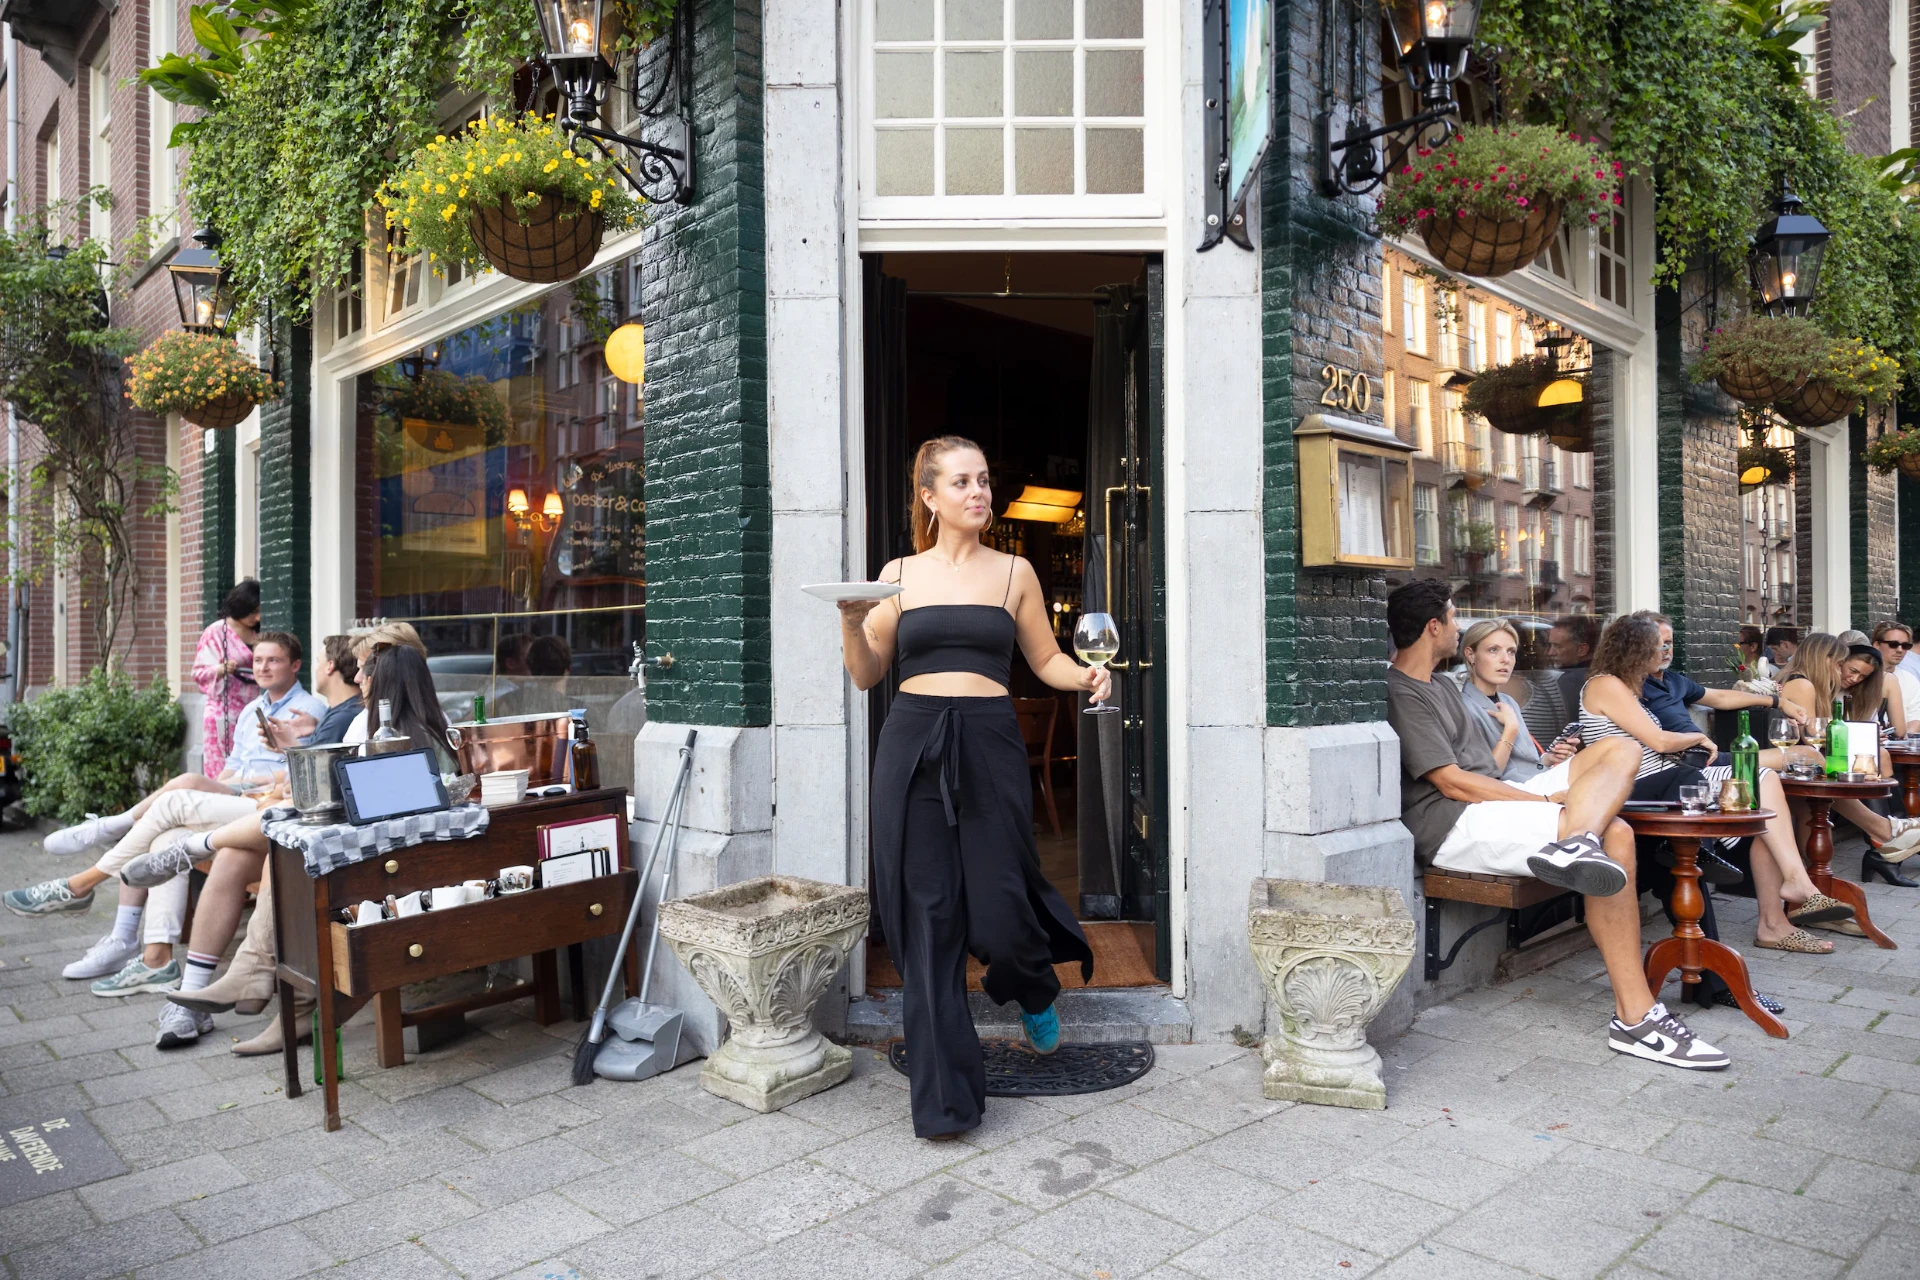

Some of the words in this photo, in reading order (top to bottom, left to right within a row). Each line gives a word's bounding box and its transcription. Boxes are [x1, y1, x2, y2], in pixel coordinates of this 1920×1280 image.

[1321, 365, 1371, 413] 250
[41, 1118, 71, 1132] DE
[9, 1126, 64, 1174] DAVERENDE
